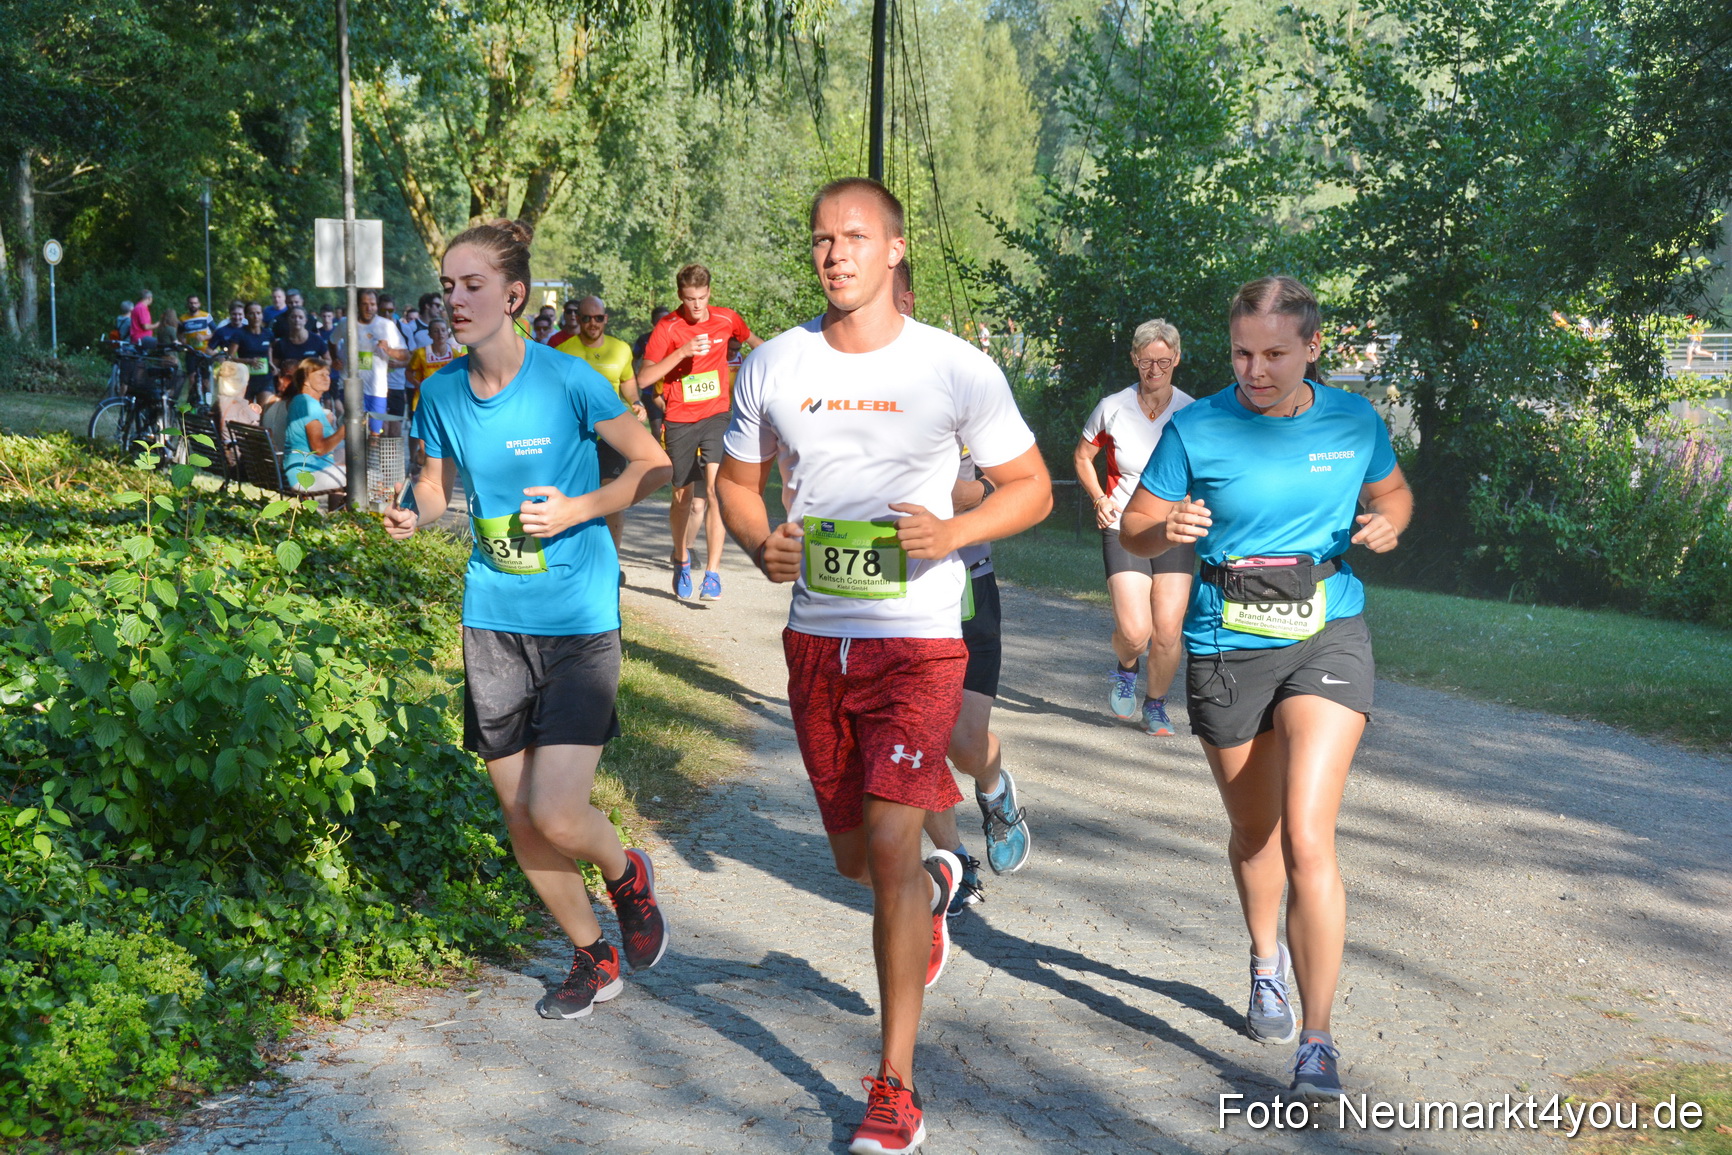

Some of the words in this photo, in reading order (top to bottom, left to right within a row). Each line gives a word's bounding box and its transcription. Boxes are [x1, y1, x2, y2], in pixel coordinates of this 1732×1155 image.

[688, 381, 715, 393] 1496
[827, 400, 904, 413] KLEBL
[513, 437, 551, 447] PFLEIDERER
[515, 448, 543, 456] Merima
[1317, 451, 1355, 460] PFLEIDERER
[1310, 465, 1332, 473] Anna
[480, 535, 526, 559] 537
[824, 547, 881, 577] 878
[819, 574, 845, 583] Keltsch
[847, 577, 890, 585] Constantin
[1239, 611, 1264, 621] Brandl
[1266, 615, 1308, 627] Anna-Lena
